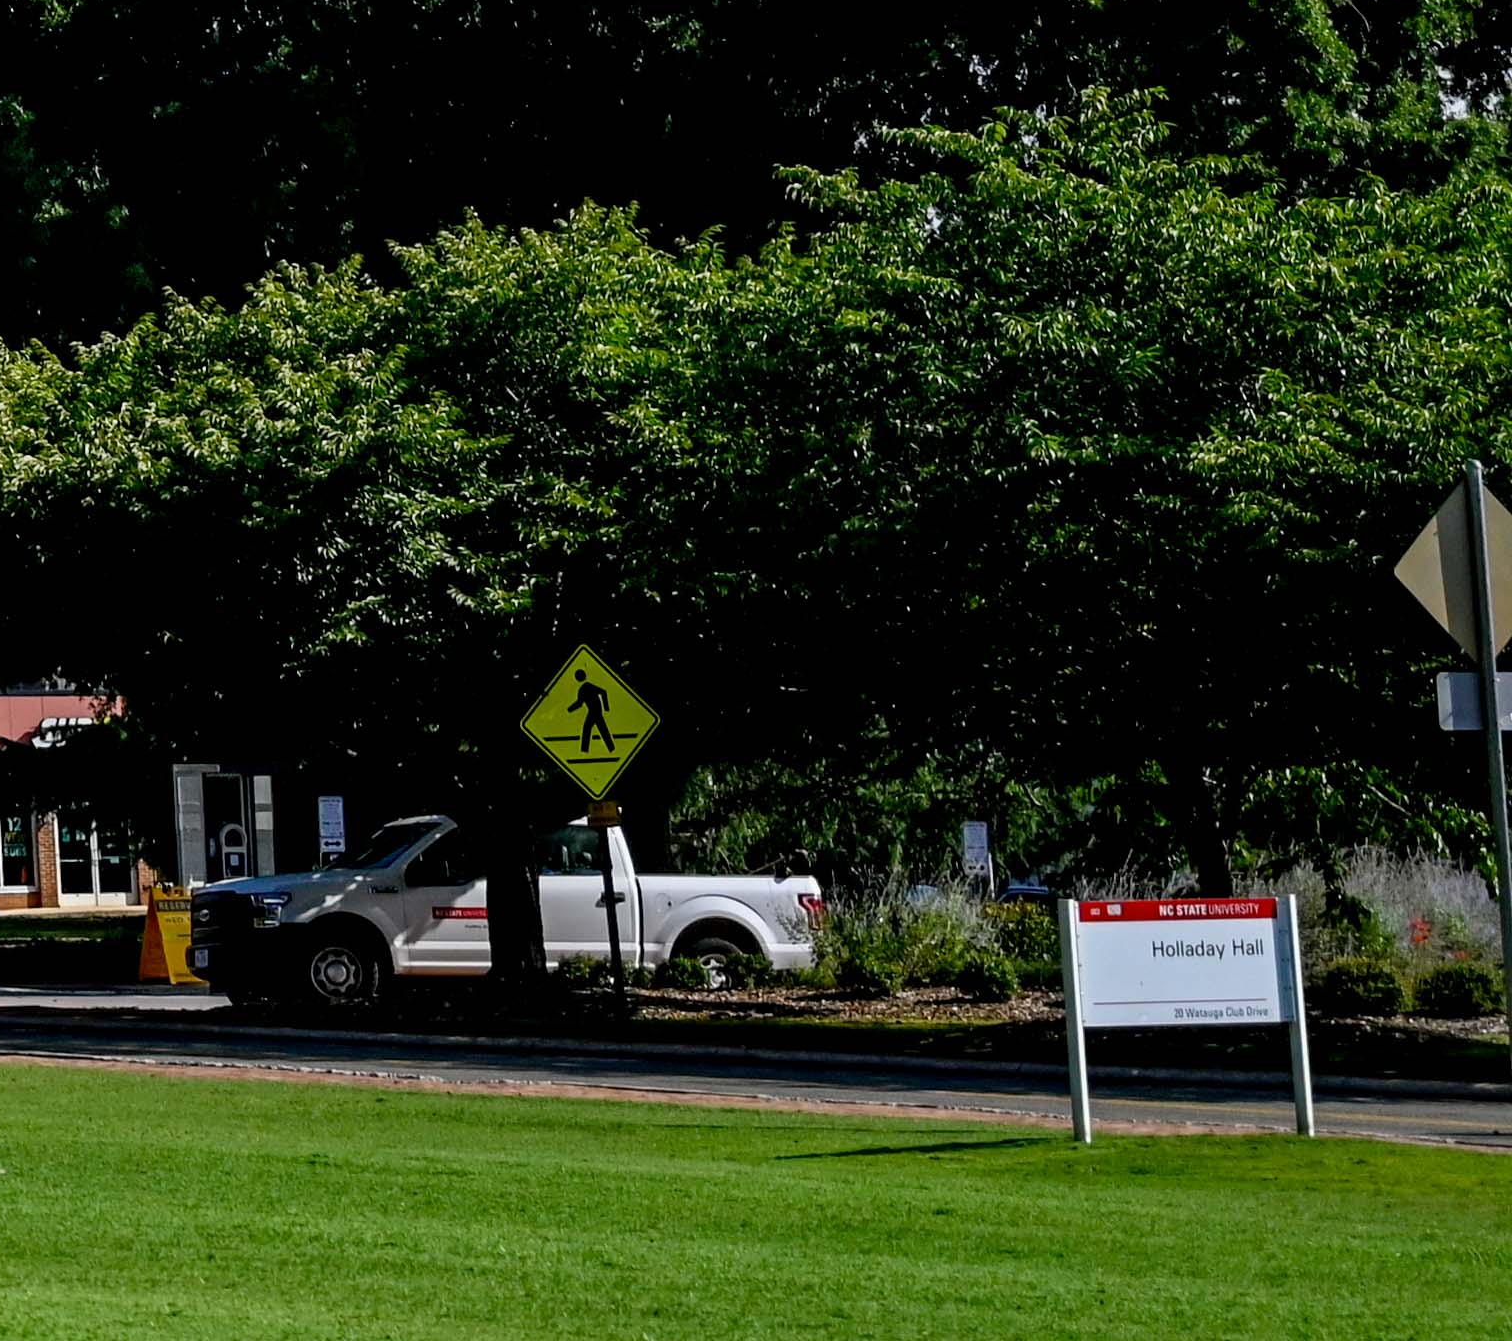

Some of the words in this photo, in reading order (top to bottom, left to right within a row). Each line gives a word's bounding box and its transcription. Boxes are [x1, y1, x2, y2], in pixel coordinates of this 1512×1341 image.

[1159, 904, 1174, 916] NC
[1176, 903, 1207, 916] STATE
[1209, 903, 1259, 915] UNIVERSITY
[1152, 939, 1225, 960] Holladay
[1232, 938, 1264, 956] Hall
[1185, 1008, 1224, 1019] Watauga
[1226, 1007, 1245, 1017] Club
[1246, 1006, 1268, 1016] Drive
